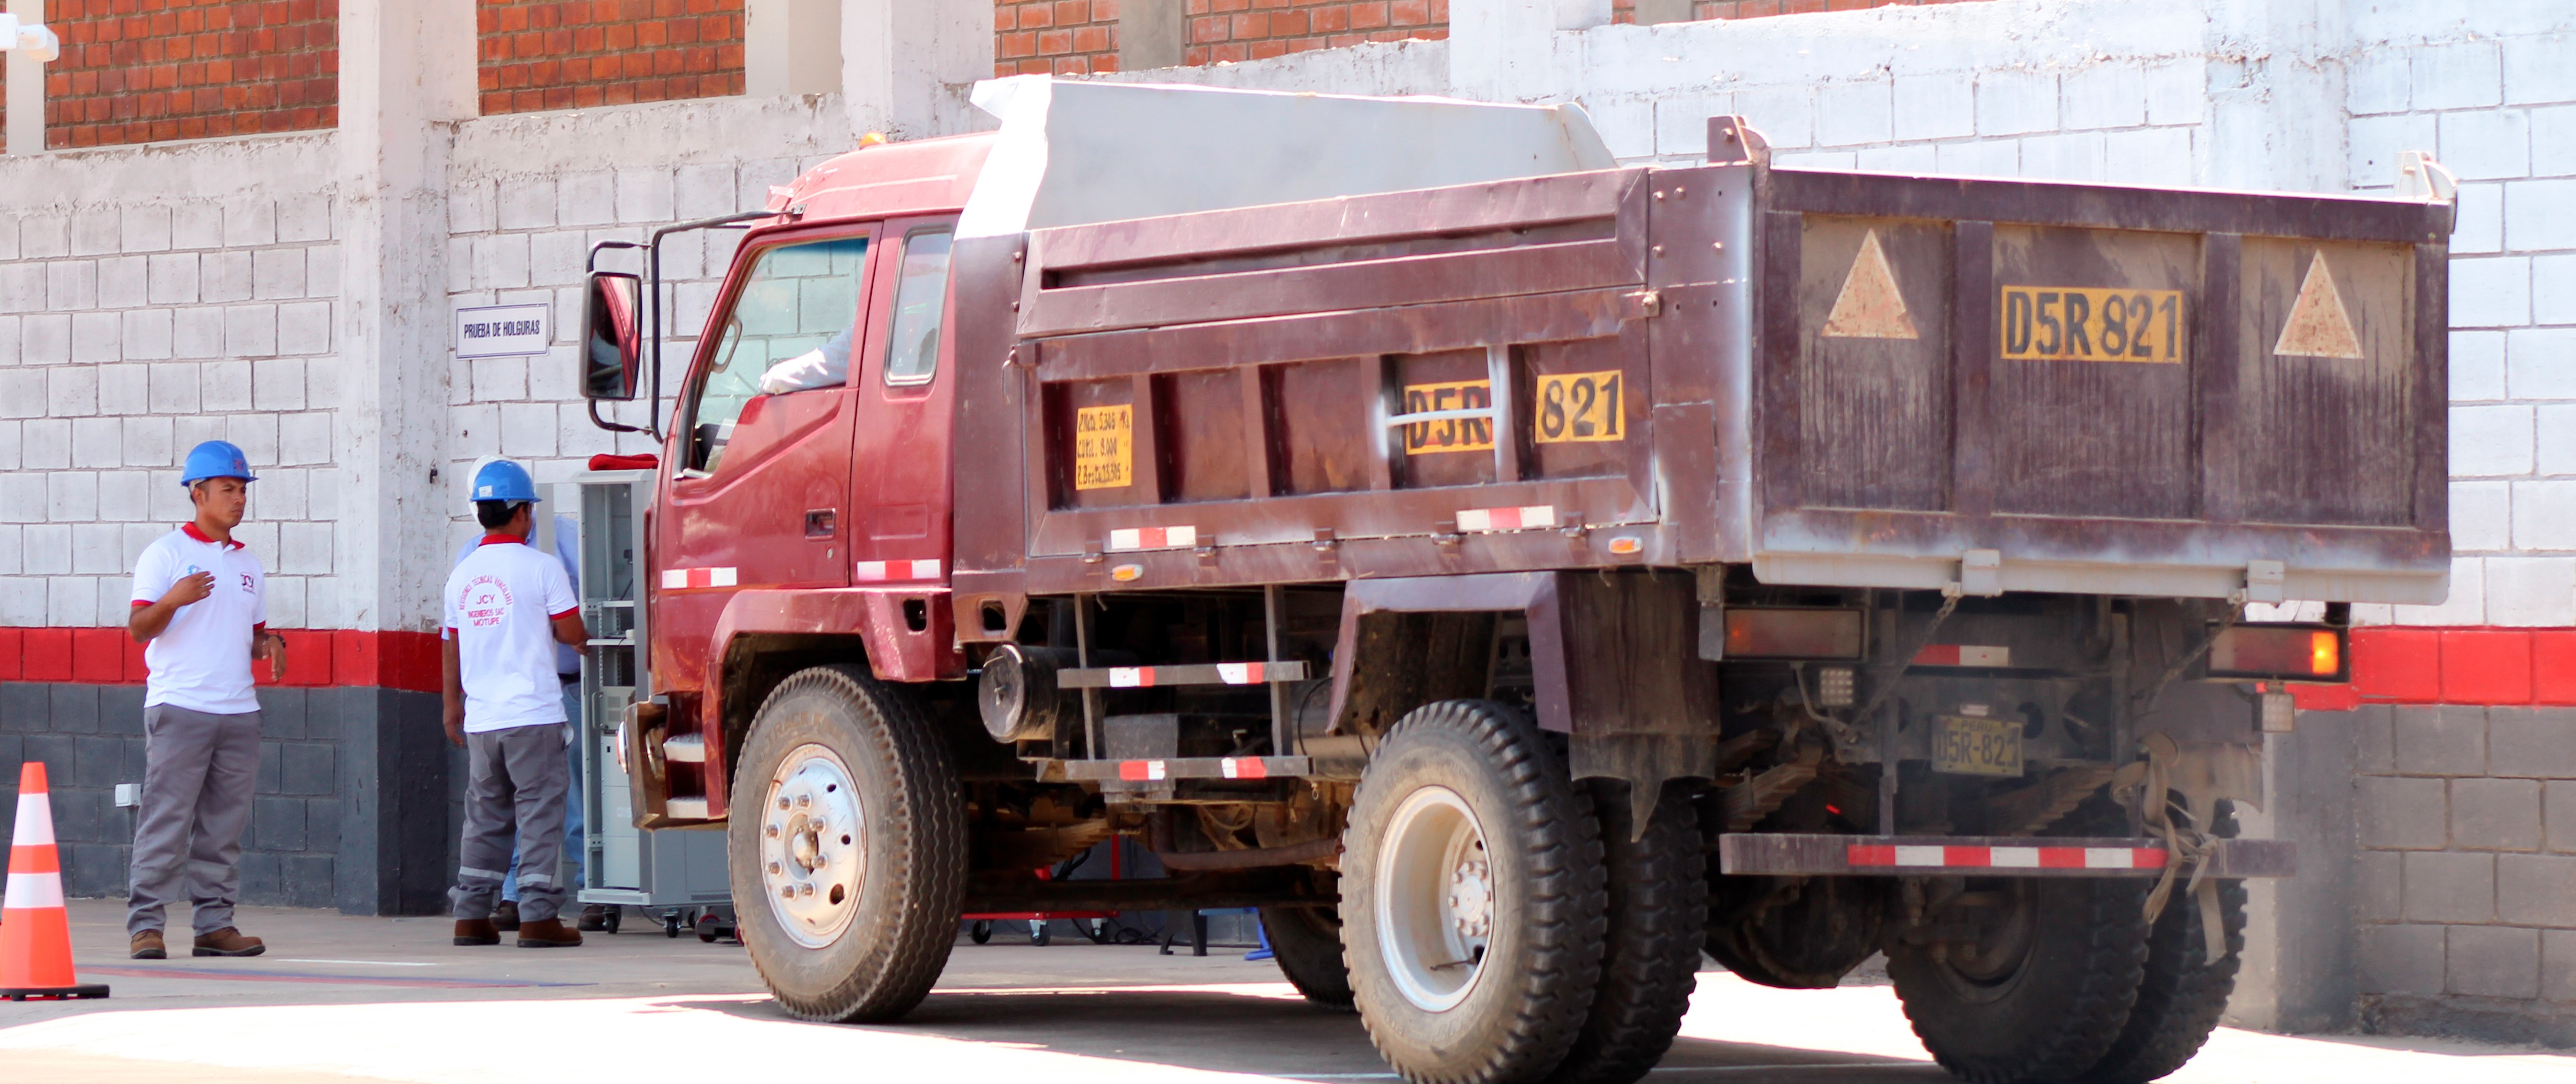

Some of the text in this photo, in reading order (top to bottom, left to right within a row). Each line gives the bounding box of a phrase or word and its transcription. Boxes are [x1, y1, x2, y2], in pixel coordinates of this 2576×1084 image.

[464, 320, 540, 339] PRUEBA DE HOLGURAS
[2007, 292, 2177, 358] D5R 821
[1410, 375, 1619, 449] D5R 821
[476, 595, 495, 604] JCY
[474, 617, 500, 627] MOTUPE
